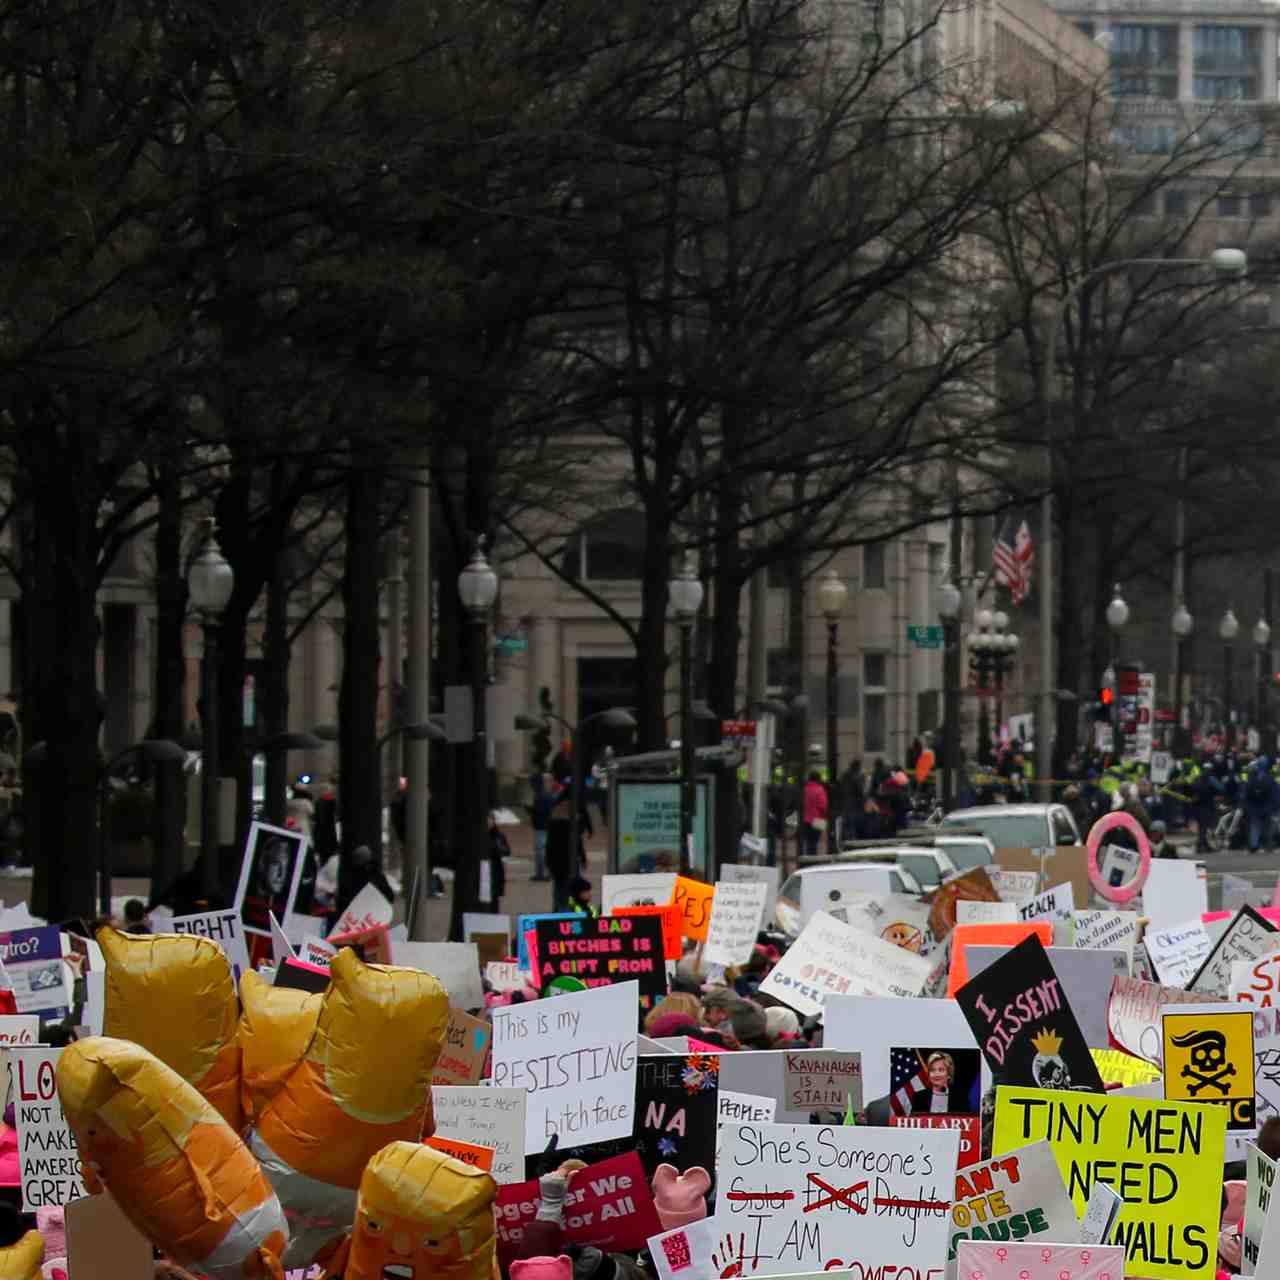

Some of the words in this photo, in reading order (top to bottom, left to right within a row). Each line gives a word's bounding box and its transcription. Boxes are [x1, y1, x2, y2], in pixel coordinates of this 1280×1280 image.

[1020, 895, 1056, 921] TEACH
[560, 921, 582, 935] US
[598, 919, 632, 933] BAD
[548, 938, 621, 955] BITCHES
[633, 937, 650, 950] IS
[543, 962, 554, 975] A
[560, 960, 598, 973] GIFT
[608, 958, 653, 972] FROM
[496, 1012, 528, 1040] This
[536, 1013, 548, 1034] is
[984, 977, 1061, 1066] DISSENT
[493, 1041, 636, 1093] RESISTING
[787, 1055, 860, 1074] KAVANAUGH
[799, 1077, 815, 1089] IS
[792, 1089, 842, 1104] STAIN
[21, 1107, 51, 1124] NOT
[896, 1118, 973, 1131] HILLARY
[1009, 1098, 1109, 1144] TINY
[1127, 1107, 1203, 1155] MEN
[24, 1131, 77, 1152] MAKE
[816, 1131, 934, 1177] Someone's
[590, 1175, 632, 1196] We
[1068, 1160, 1179, 1206] NEED
[601, 1196, 636, 1221] All
[777, 1223, 822, 1262] AM
